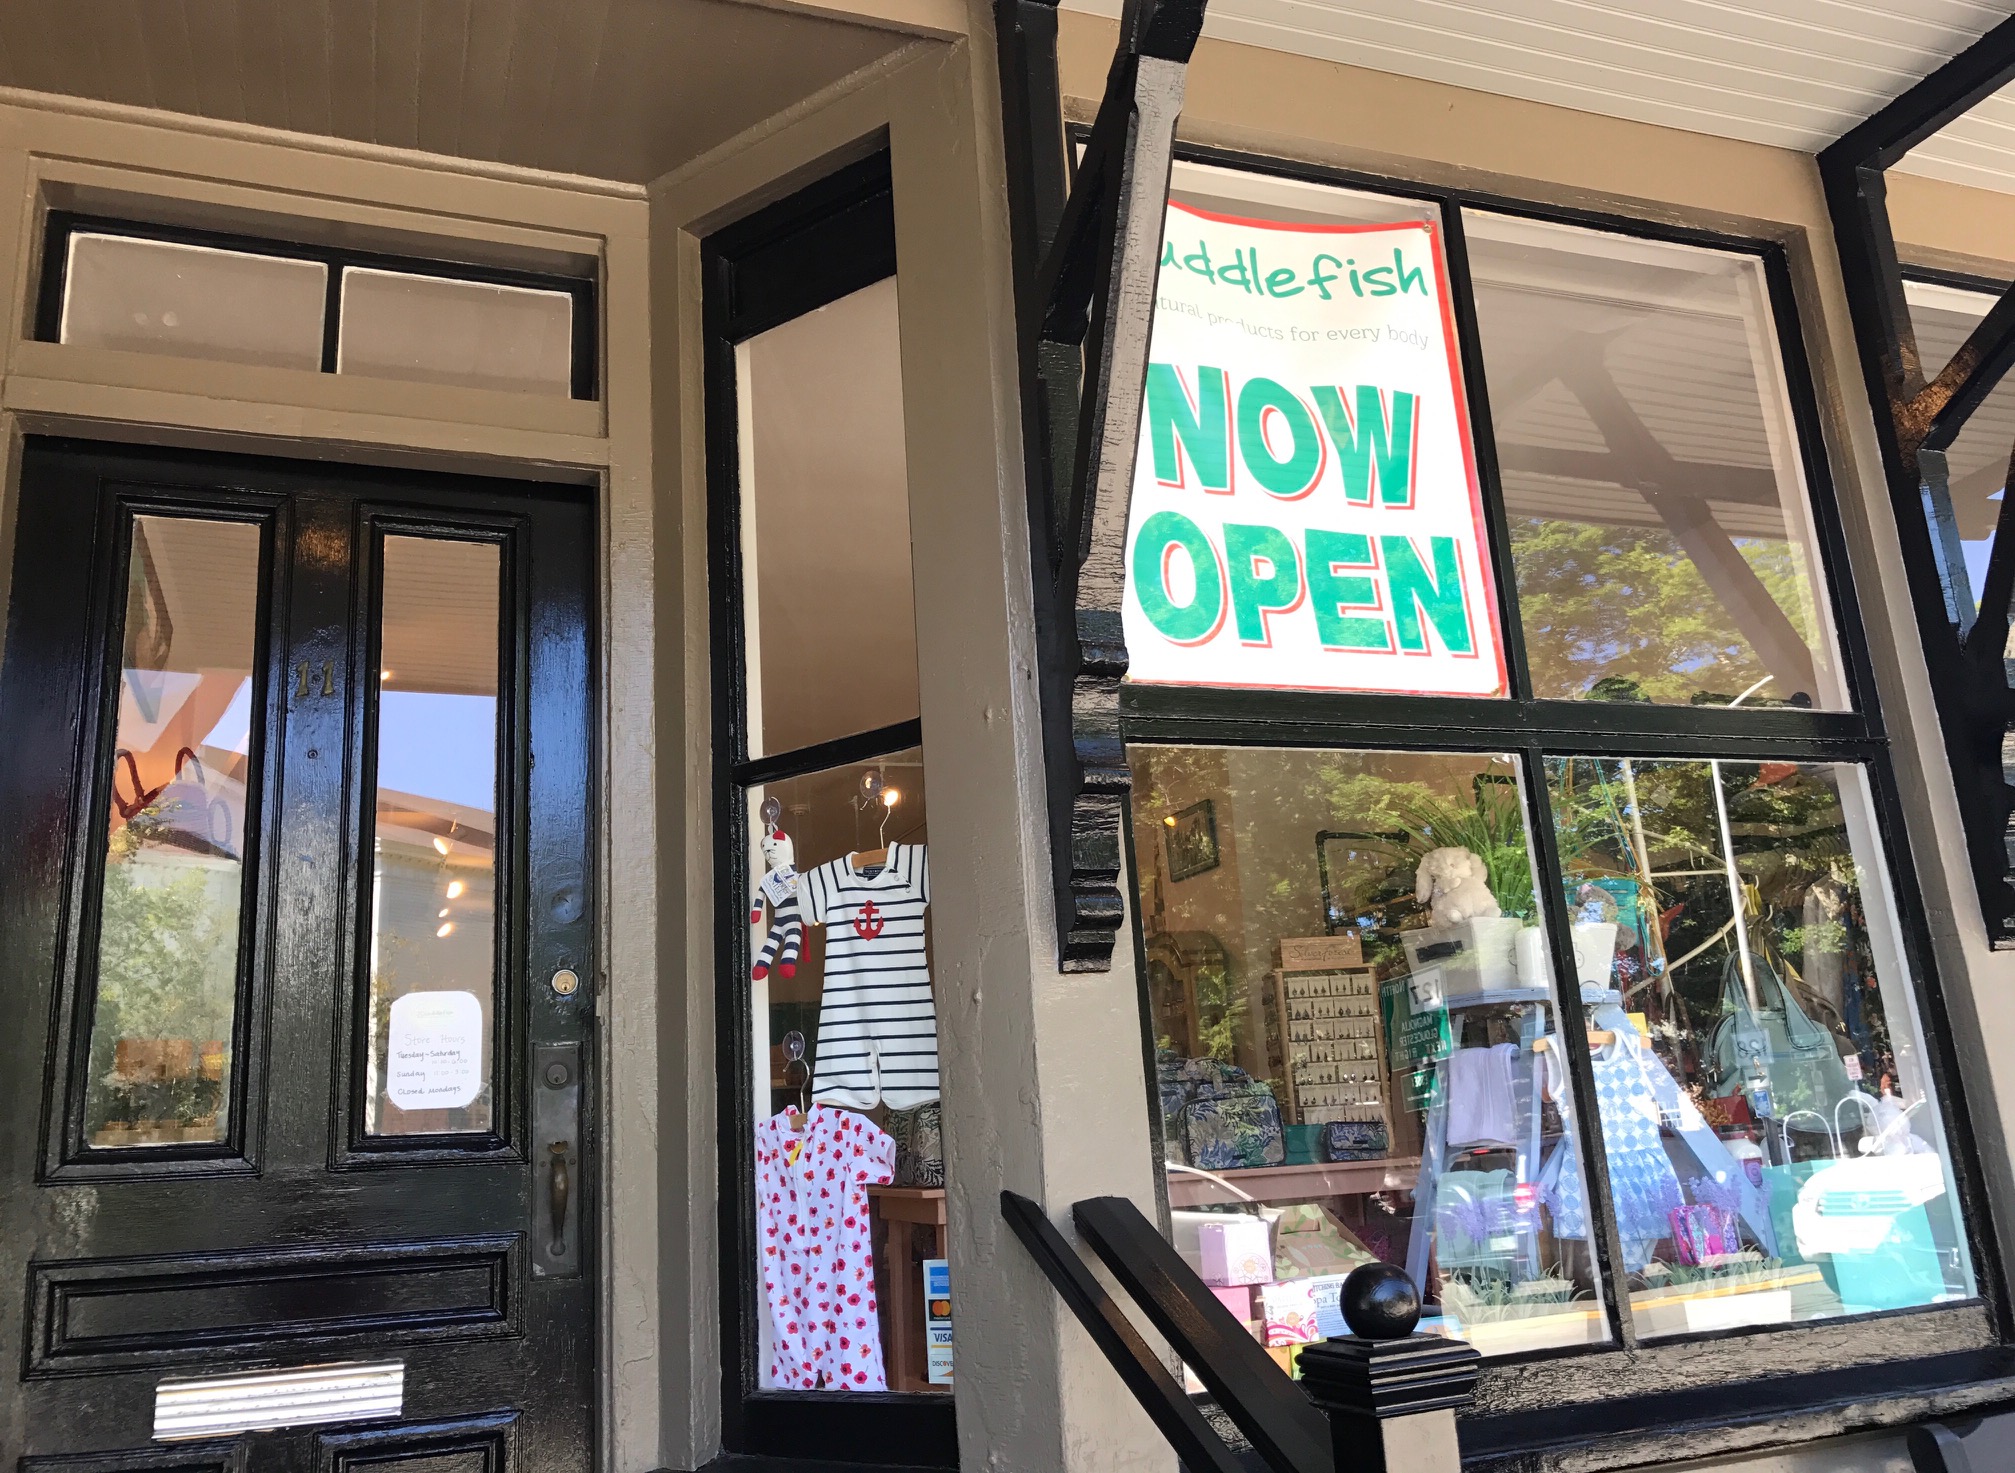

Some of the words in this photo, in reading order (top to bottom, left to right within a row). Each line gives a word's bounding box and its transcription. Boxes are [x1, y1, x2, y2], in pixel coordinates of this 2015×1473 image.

[1160, 240, 1429, 300] uddlefish
[1155, 296, 1203, 319] tural
[1291, 326, 1320, 342] for
[1326, 326, 1381, 343] every
[1387, 324, 1429, 350] body
[1146, 362, 1420, 510] NOW
[1133, 511, 1479, 659] OPEN
[296, 660, 334, 697] 11
[404, 1033, 431, 1047] Store
[440, 1033, 466, 1045] Hours
[396, 1069, 426, 1082] Sunday
[934, 1333, 953, 1343] VISA
